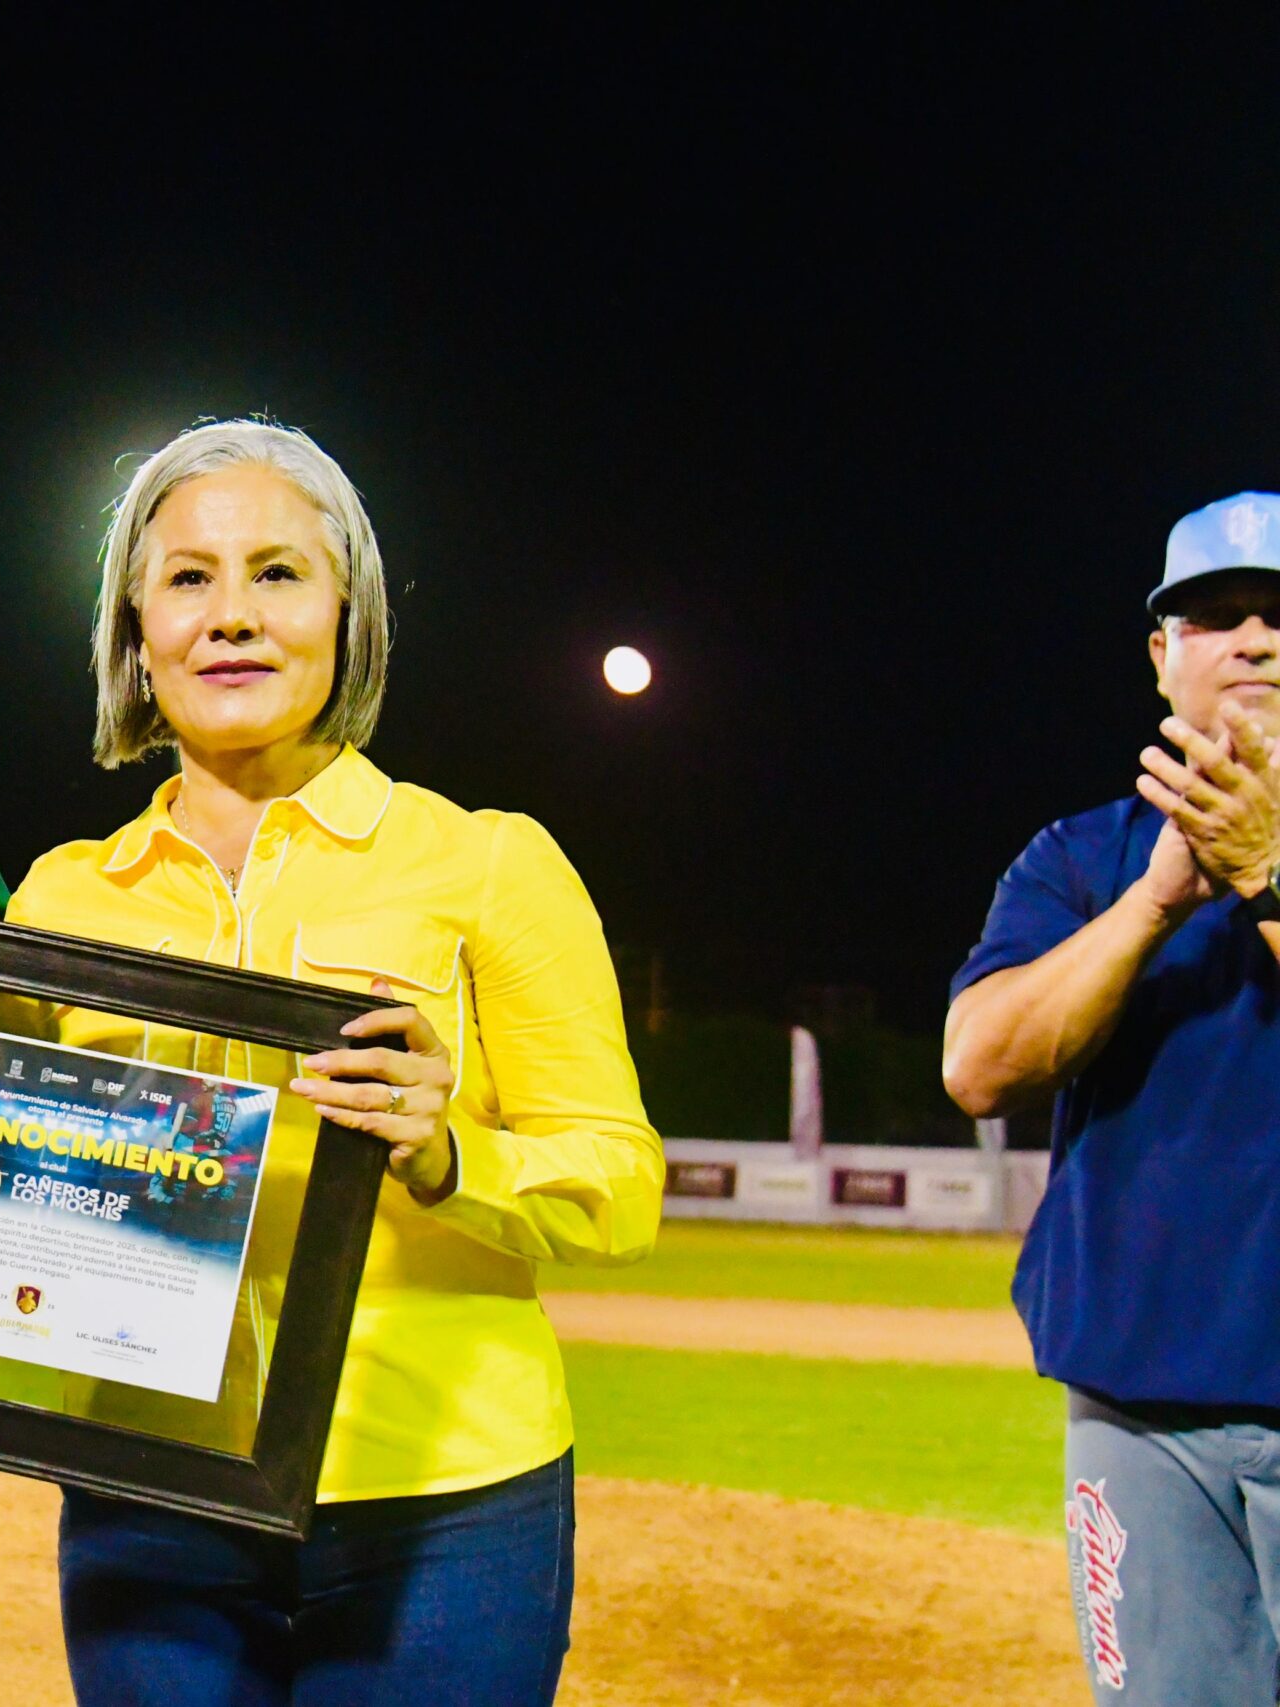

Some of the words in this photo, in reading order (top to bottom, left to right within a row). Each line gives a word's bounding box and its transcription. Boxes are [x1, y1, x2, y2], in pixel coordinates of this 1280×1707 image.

[0, 1089, 59, 1110] Ayuntamiento
[71, 1104, 109, 1118] Salvador
[110, 1112, 148, 1126] Alvarado
[149, 1091, 173, 1105] ISDE
[27, 1106, 56, 1118] otorga
[67, 1114, 104, 1128] presente
[49, 1162, 69, 1173] club
[12, 1169, 102, 1204] CAÑEROS
[103, 1191, 131, 1210] DE
[10, 1186, 47, 1206] LOS
[49, 1194, 124, 1222] MOCHIS
[76, 1332, 91, 1340] LIC.
[93, 1336, 119, 1346] ULISES
[121, 1340, 158, 1354] SÁNCHEZ
